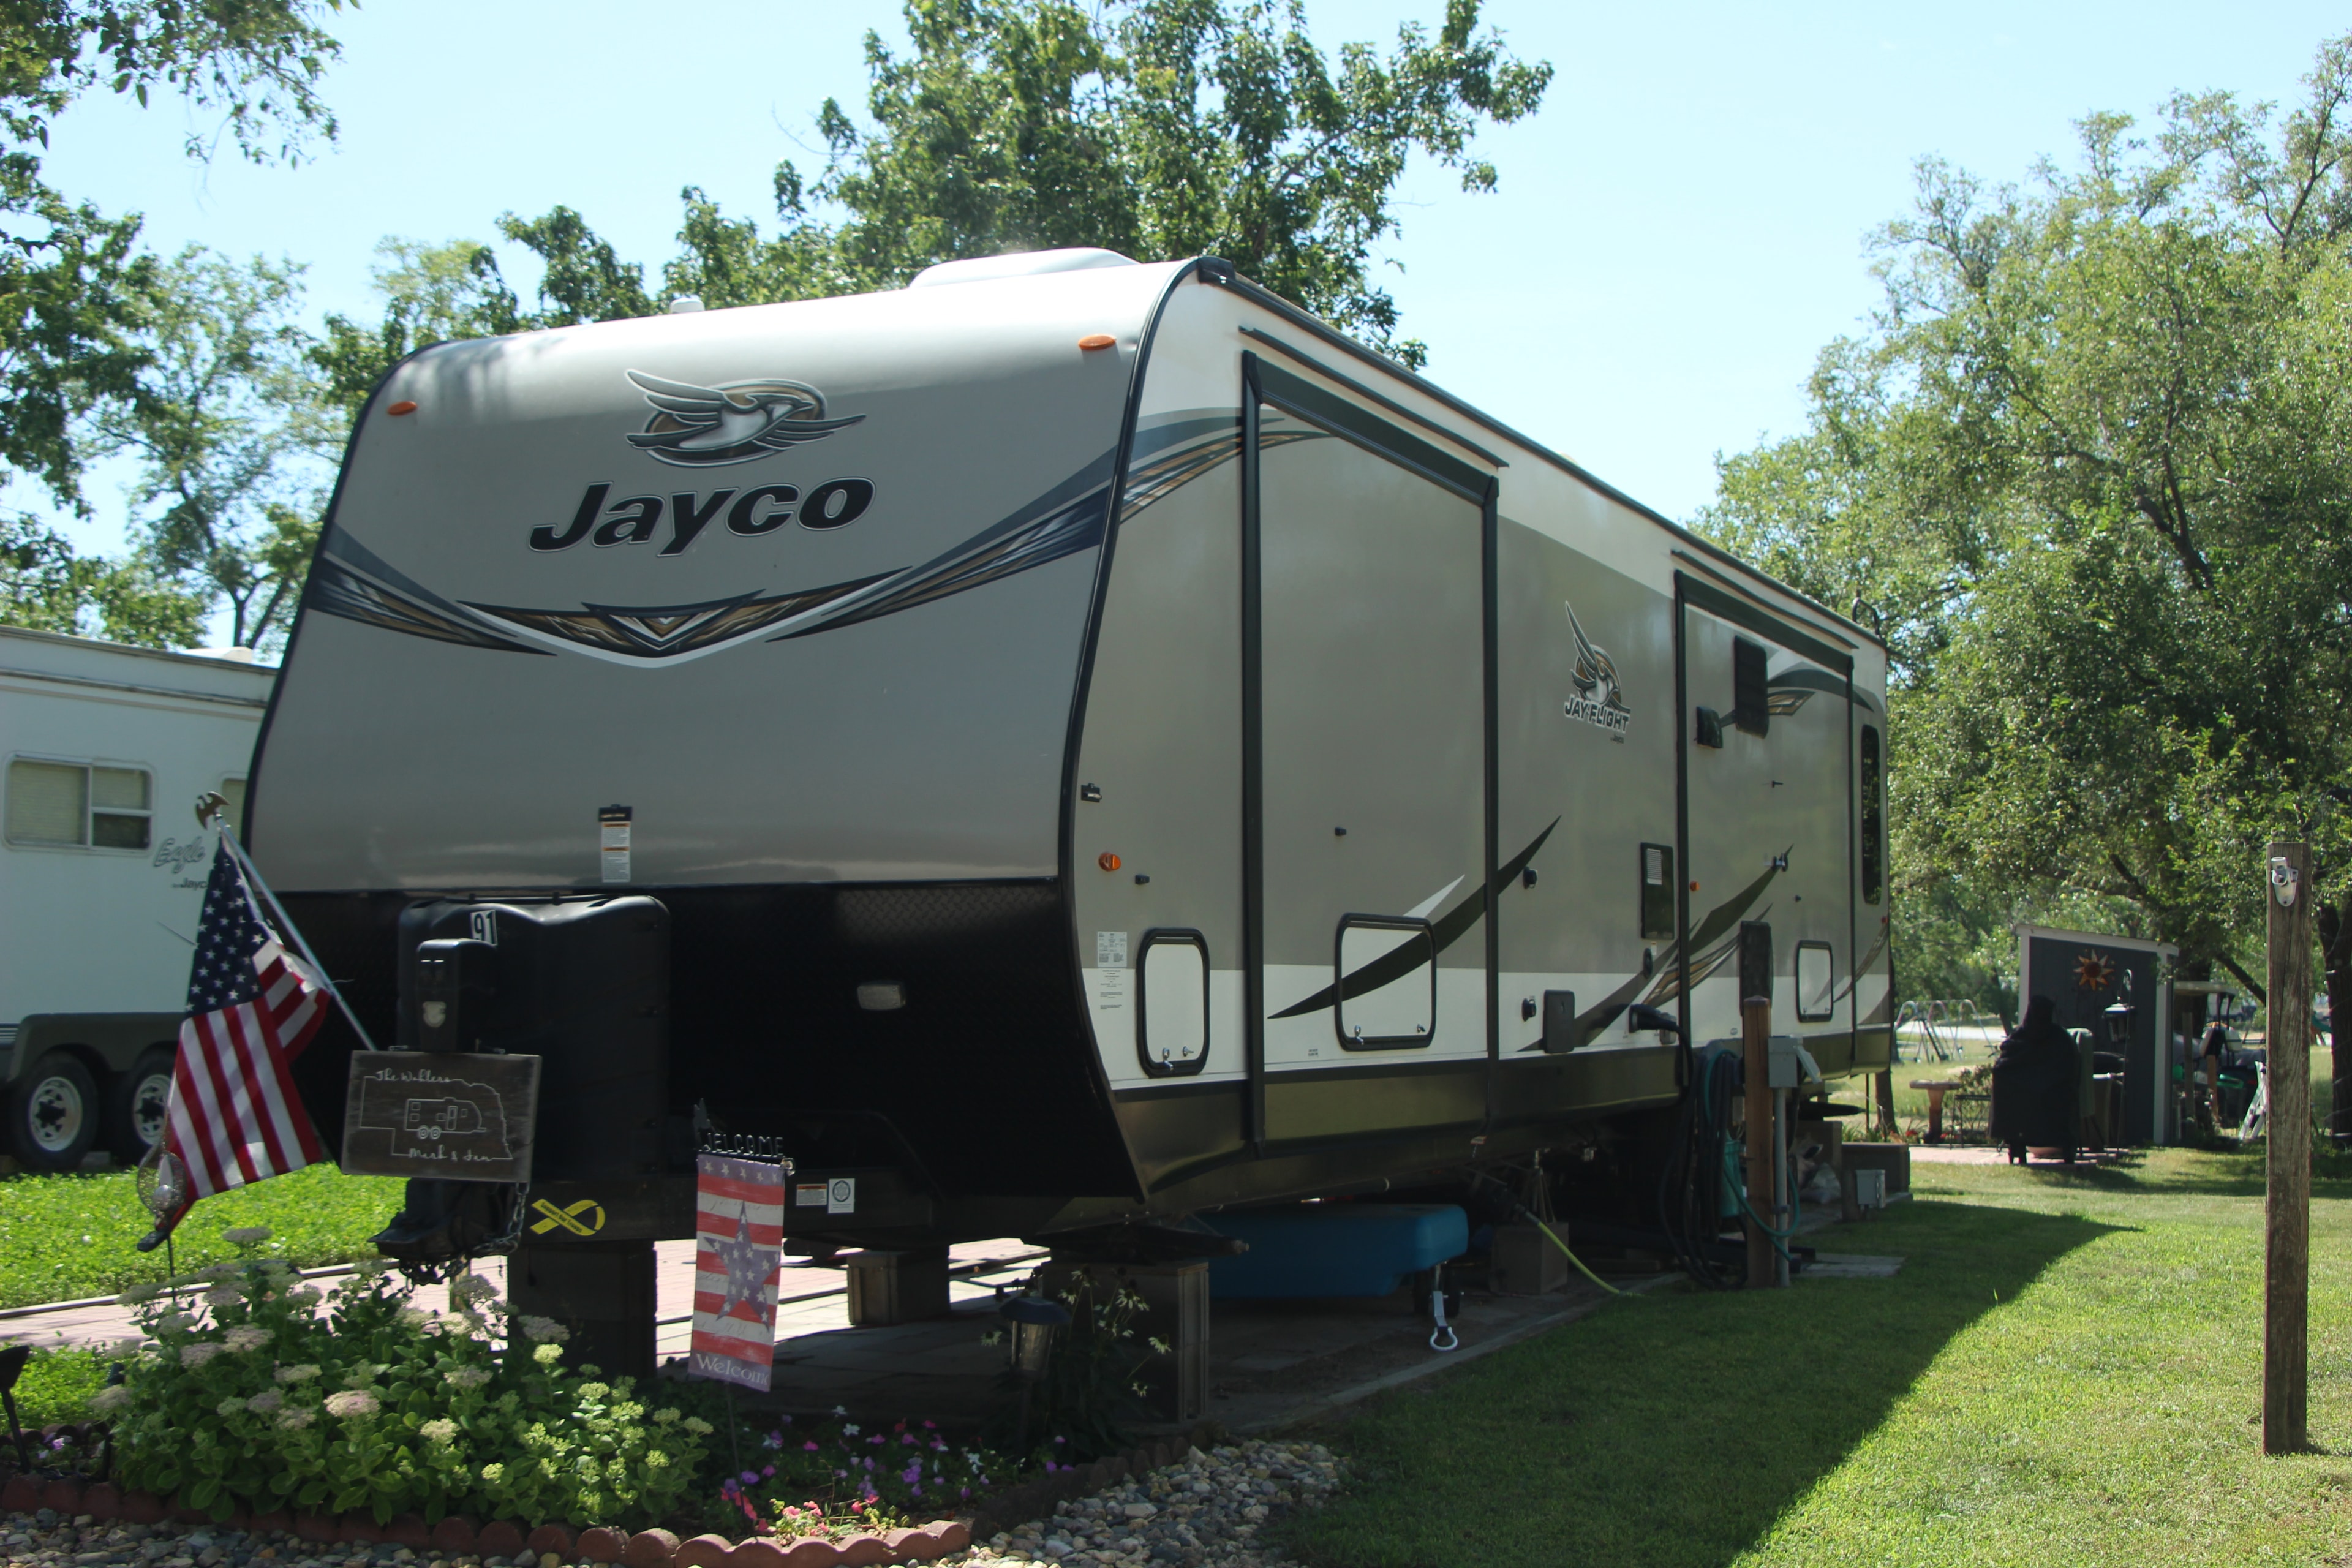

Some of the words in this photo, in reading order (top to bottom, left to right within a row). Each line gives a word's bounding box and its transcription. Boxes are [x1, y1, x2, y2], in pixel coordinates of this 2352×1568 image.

[529, 477, 877, 557] Jayco
[1564, 695, 1589, 720] JAY
[1588, 703, 1630, 733] FLIGHT
[153, 836, 206, 874] Eagle
[181, 877, 208, 891] Jayc
[473, 911, 496, 944] 91
[375, 1068, 399, 1082] The
[450, 1150, 458, 1163] &
[696, 1131, 784, 1156] WELCOME
